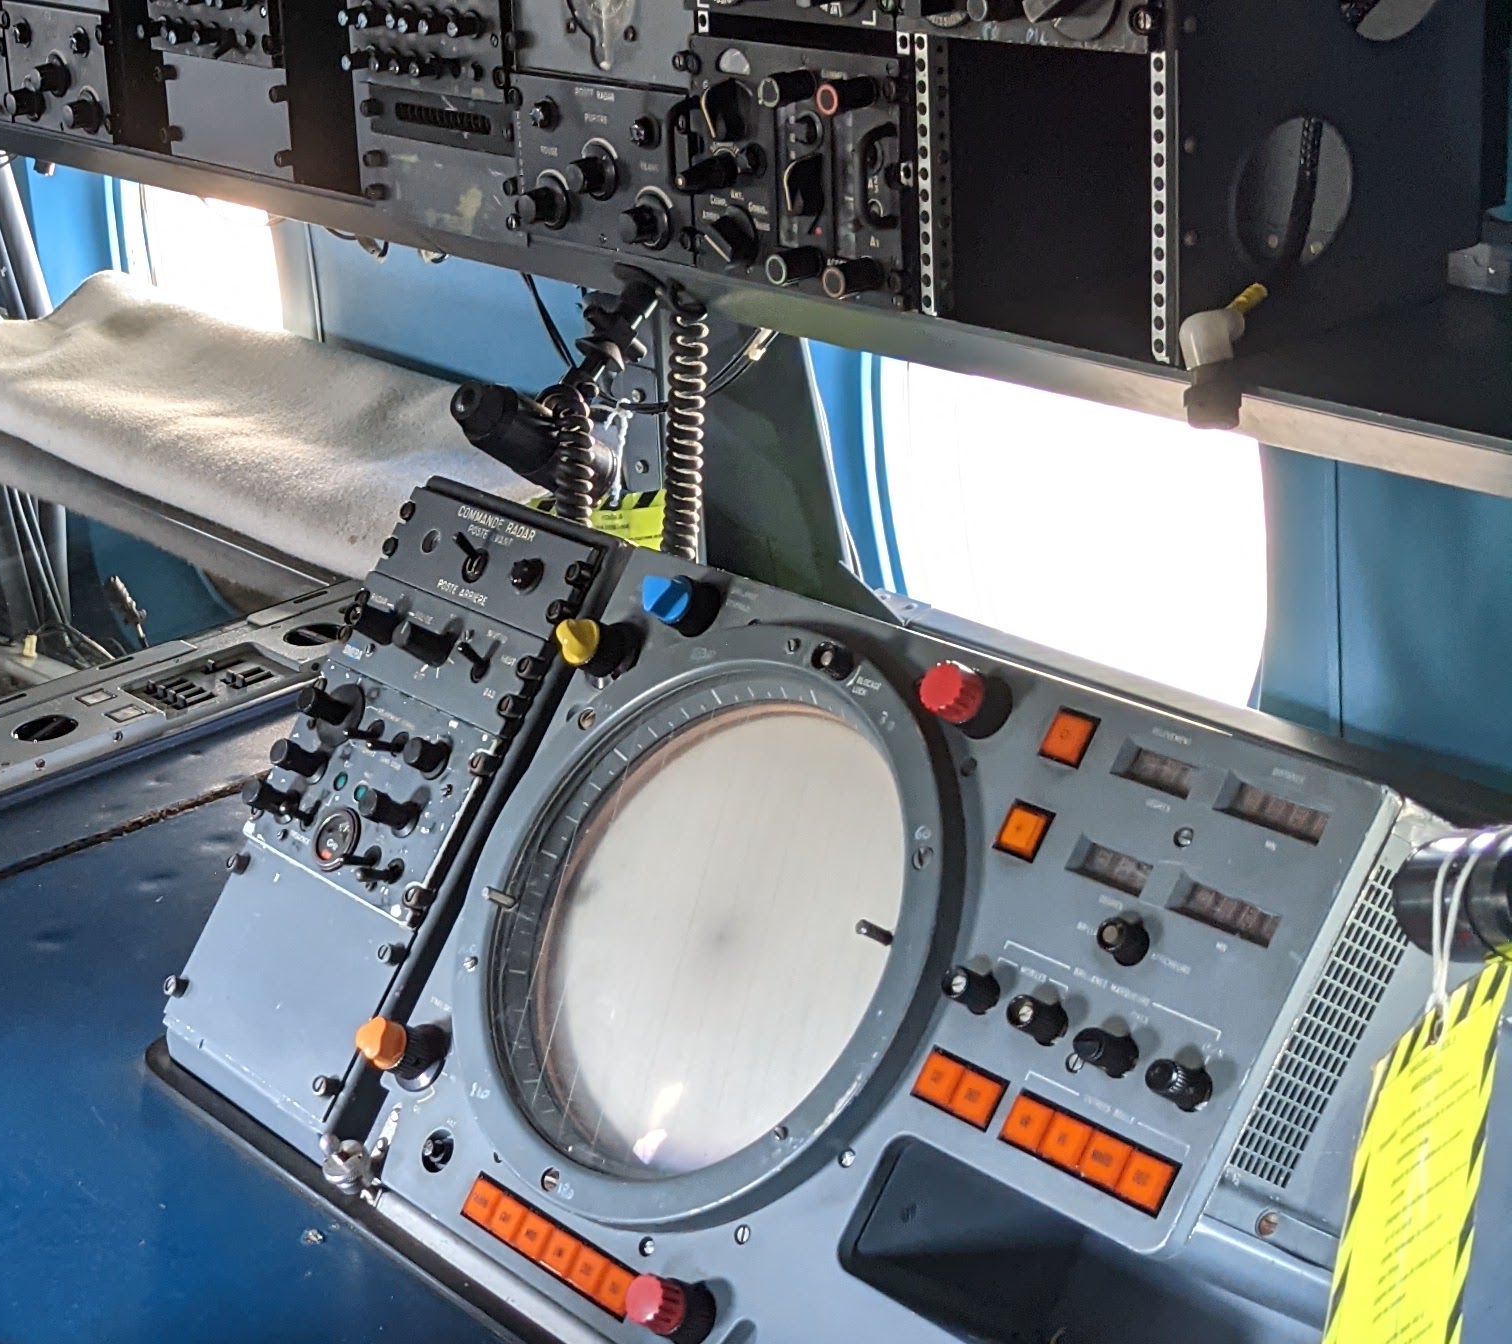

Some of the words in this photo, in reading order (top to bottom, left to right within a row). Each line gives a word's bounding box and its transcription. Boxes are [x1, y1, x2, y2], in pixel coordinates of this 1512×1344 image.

[457, 505, 504, 532] COMMANDE
[504, 522, 537, 542] RADAR
[467, 524, 489, 538] POSTE
[436, 578, 459, 596] POSTE
